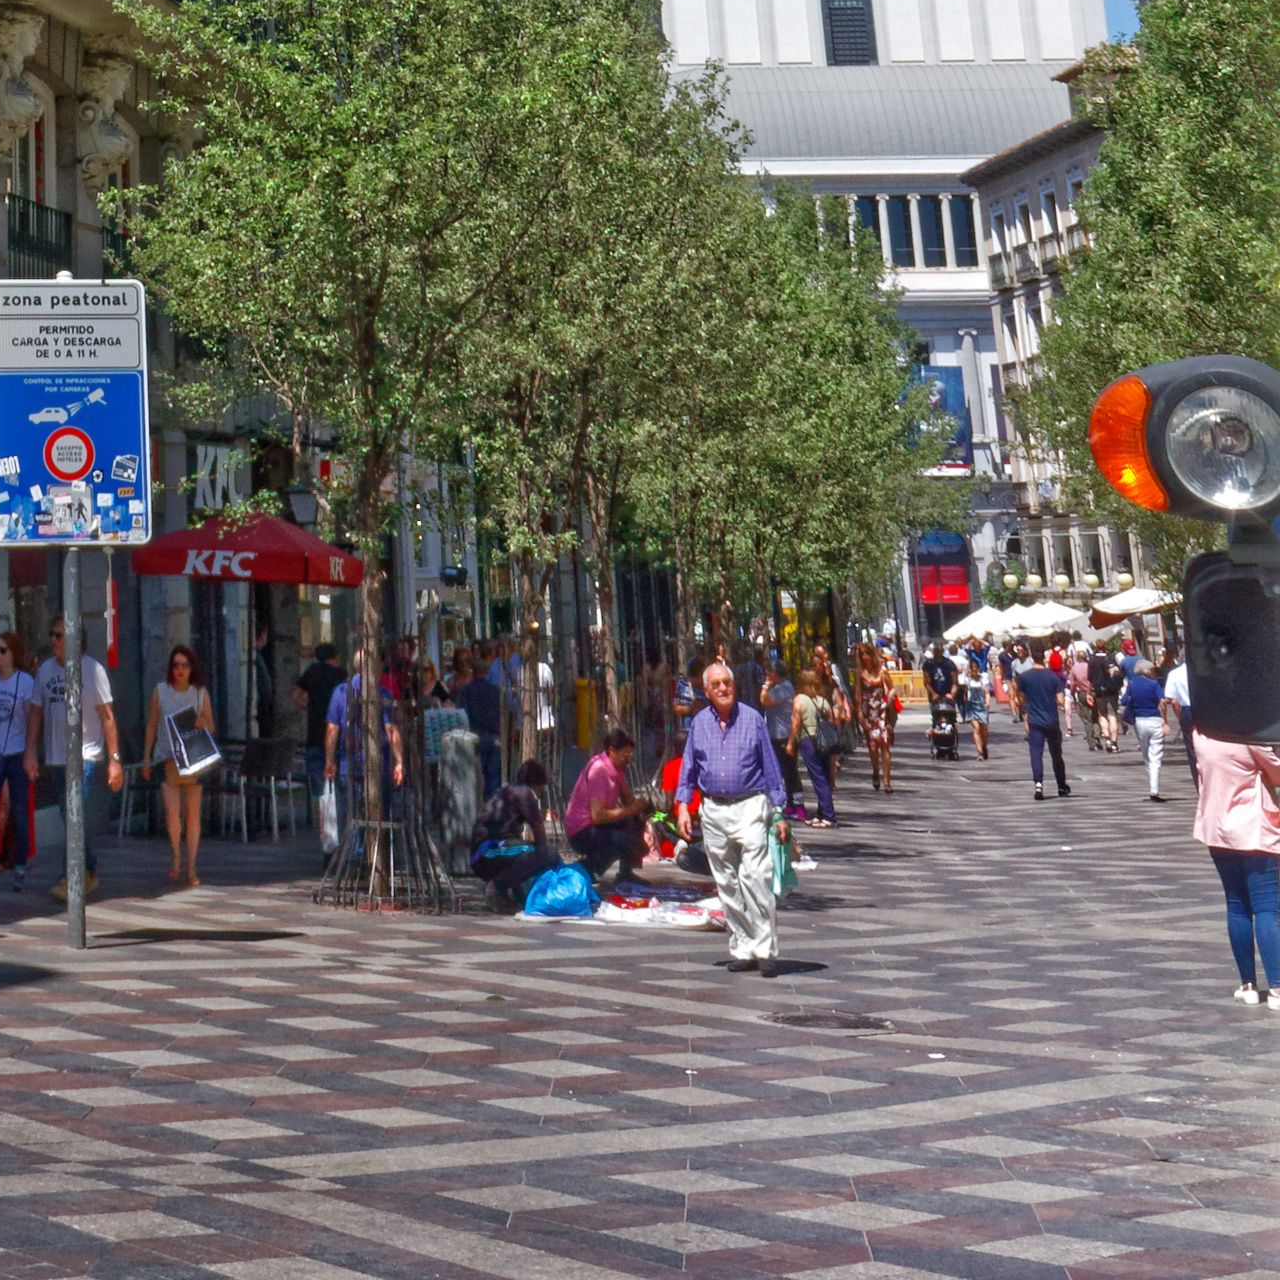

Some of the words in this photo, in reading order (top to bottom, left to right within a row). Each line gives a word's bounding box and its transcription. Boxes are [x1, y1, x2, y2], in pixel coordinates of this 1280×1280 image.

[2, 295, 43, 307] zona
[50, 292, 128, 310] peatonal
[39, 325, 95, 335] PERMITIDO
[11, 337, 50, 347] CARGA
[53, 337, 60, 346] Y
[63, 337, 122, 346] DESCARGA
[35, 349, 49, 358] DE
[66, 349, 73, 358] A
[77, 349, 85, 358] 11
[182, 549, 257, 577] KFC
[330, 555, 345, 582] KFC
